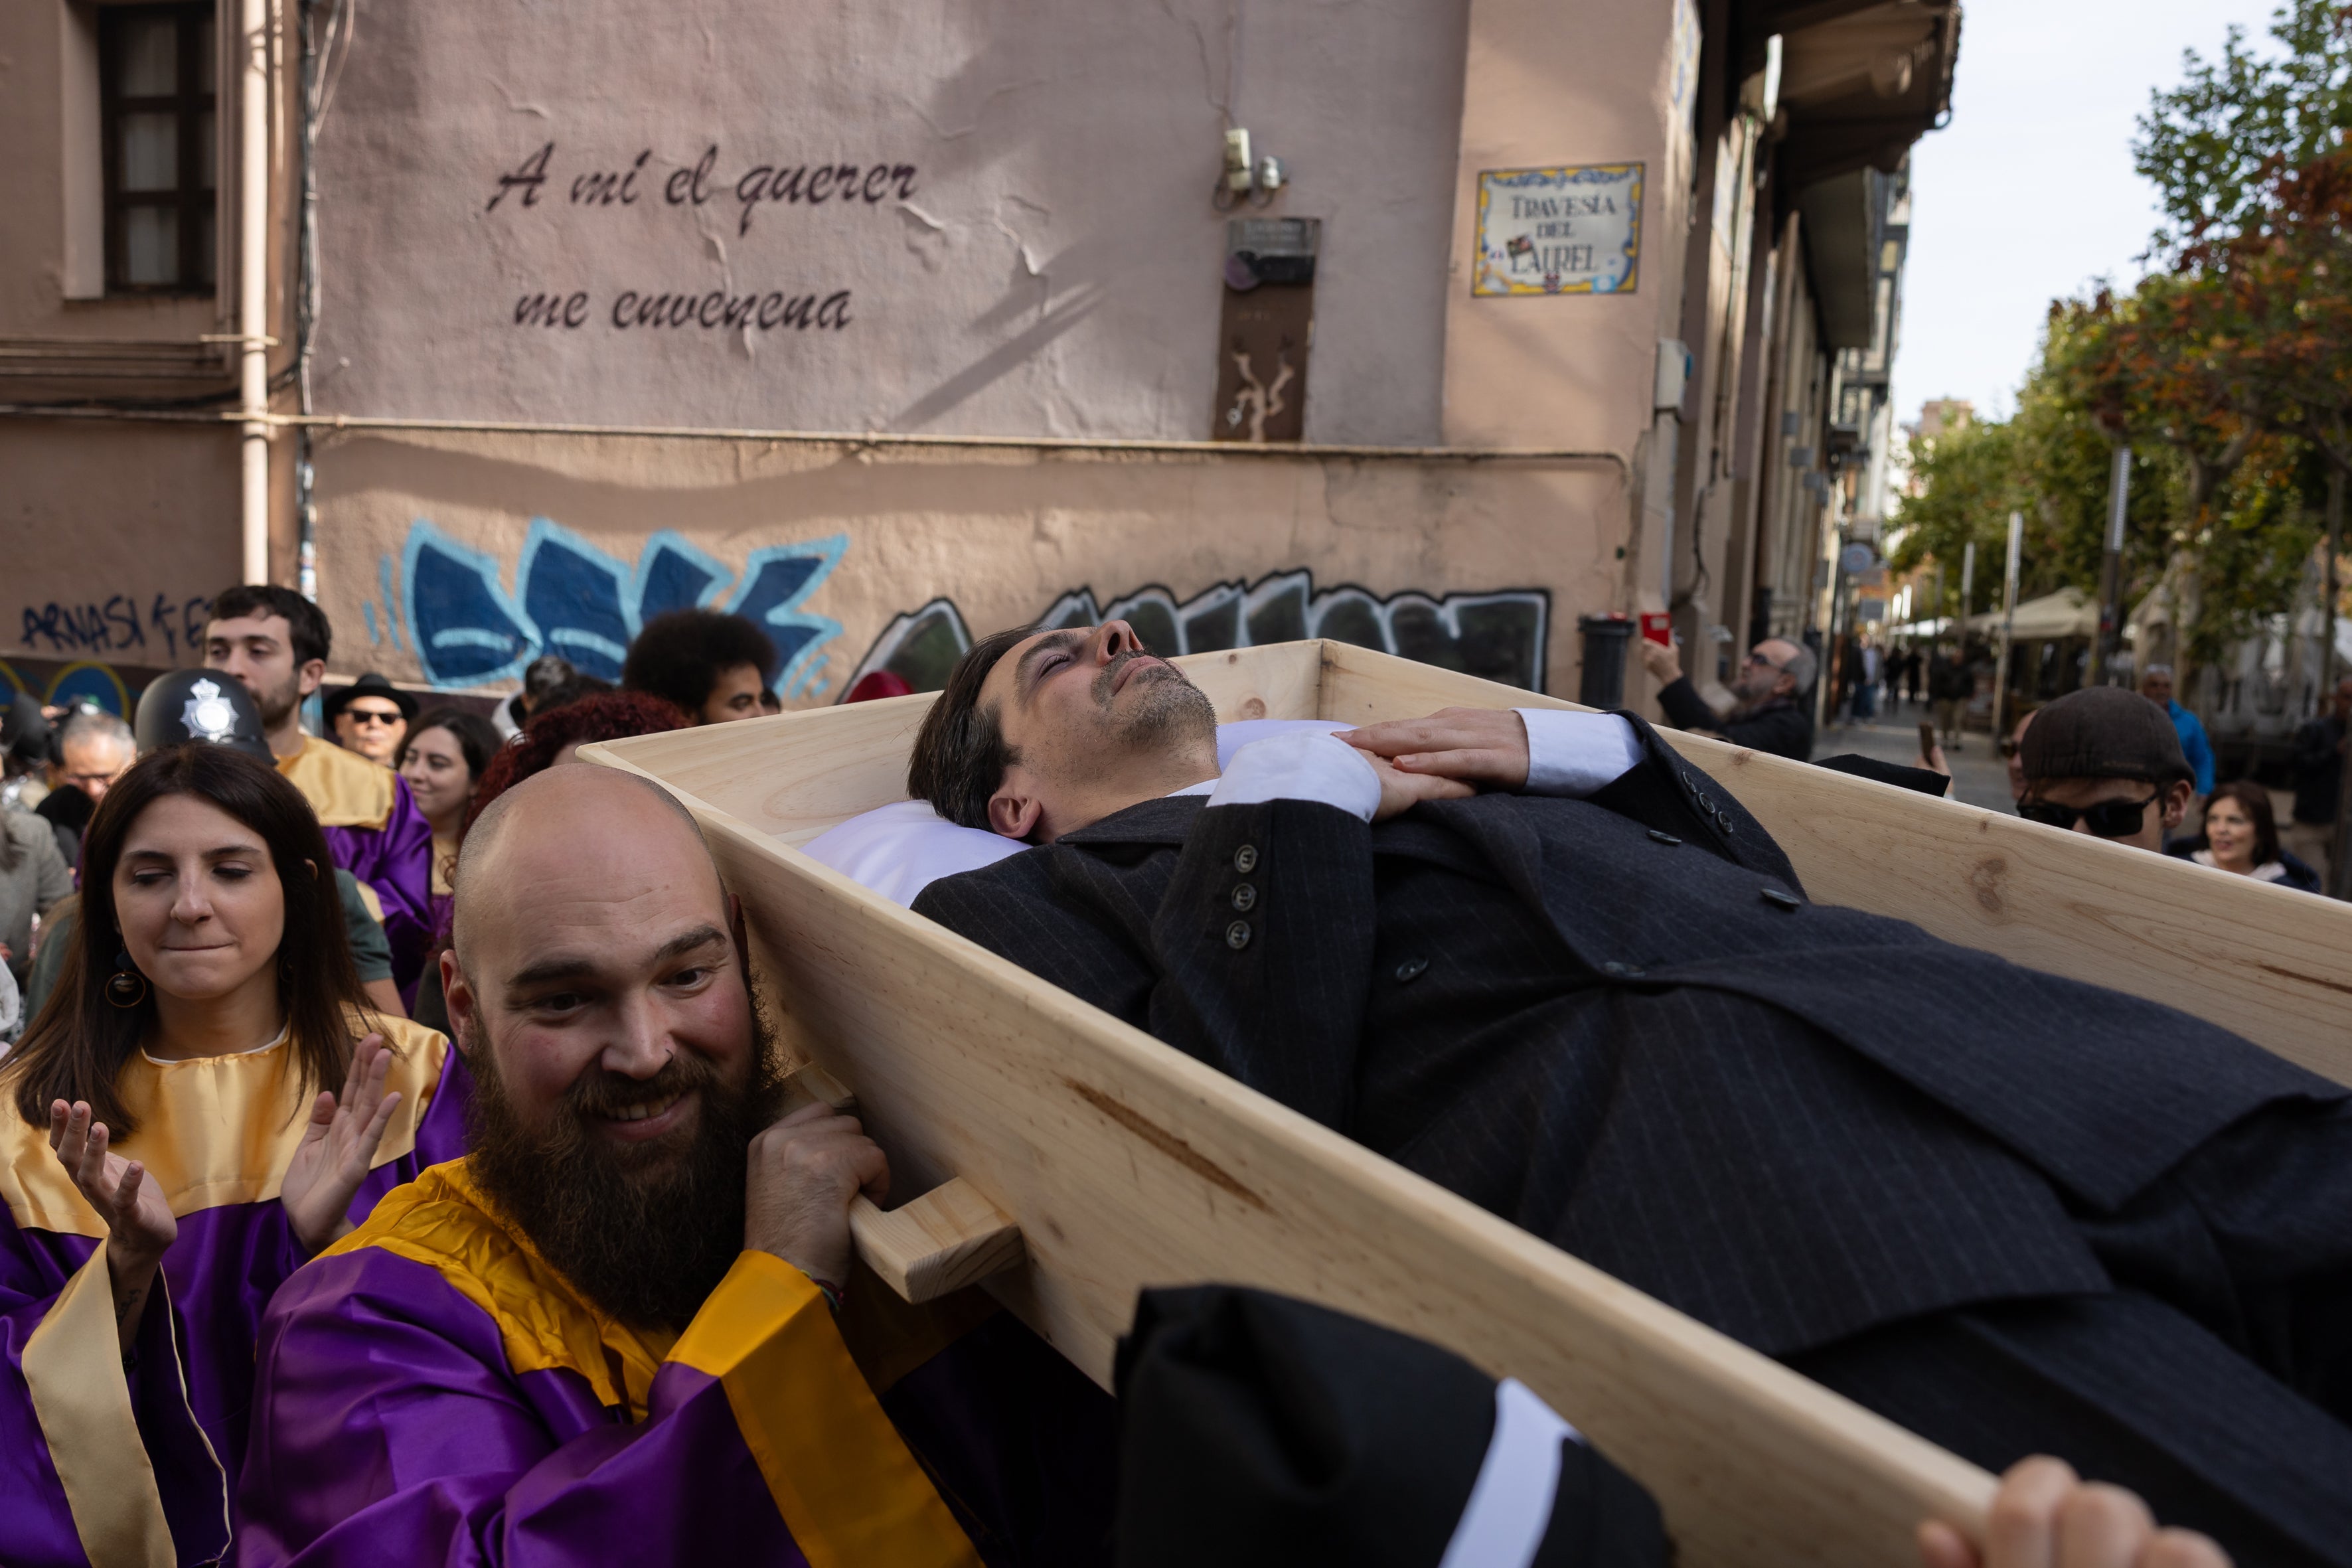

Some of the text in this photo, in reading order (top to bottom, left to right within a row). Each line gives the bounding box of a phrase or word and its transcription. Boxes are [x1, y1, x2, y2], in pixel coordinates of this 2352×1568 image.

[487, 141, 555, 212] A
[665, 143, 718, 207] el
[736, 161, 919, 238] querer
[1536, 220, 1577, 239] DEL
[514, 289, 852, 332] me envenena
